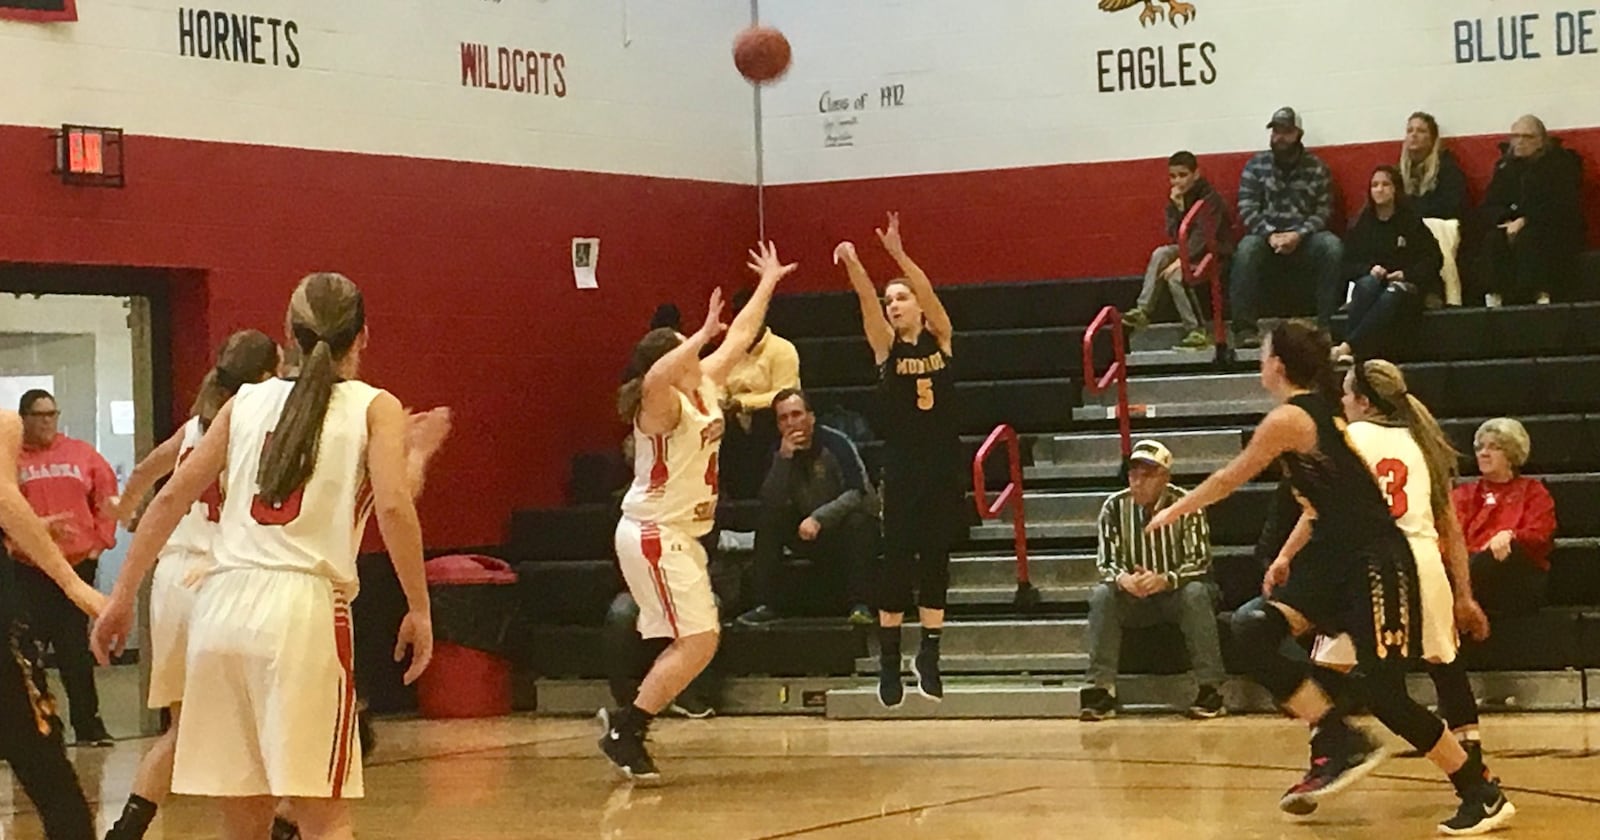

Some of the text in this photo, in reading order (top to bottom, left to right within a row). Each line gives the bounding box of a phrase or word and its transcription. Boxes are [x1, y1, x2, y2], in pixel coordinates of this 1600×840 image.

[179, 7, 300, 68] HORNETS
[1454, 13, 1541, 63] BLUE
[461, 42, 566, 98] WILDCATS
[1097, 41, 1217, 93] EAGLES
[819, 90, 849, 113] Class
[854, 92, 868, 110] of
[916, 378, 934, 410] 5
[1376, 457, 1408, 519] 3
